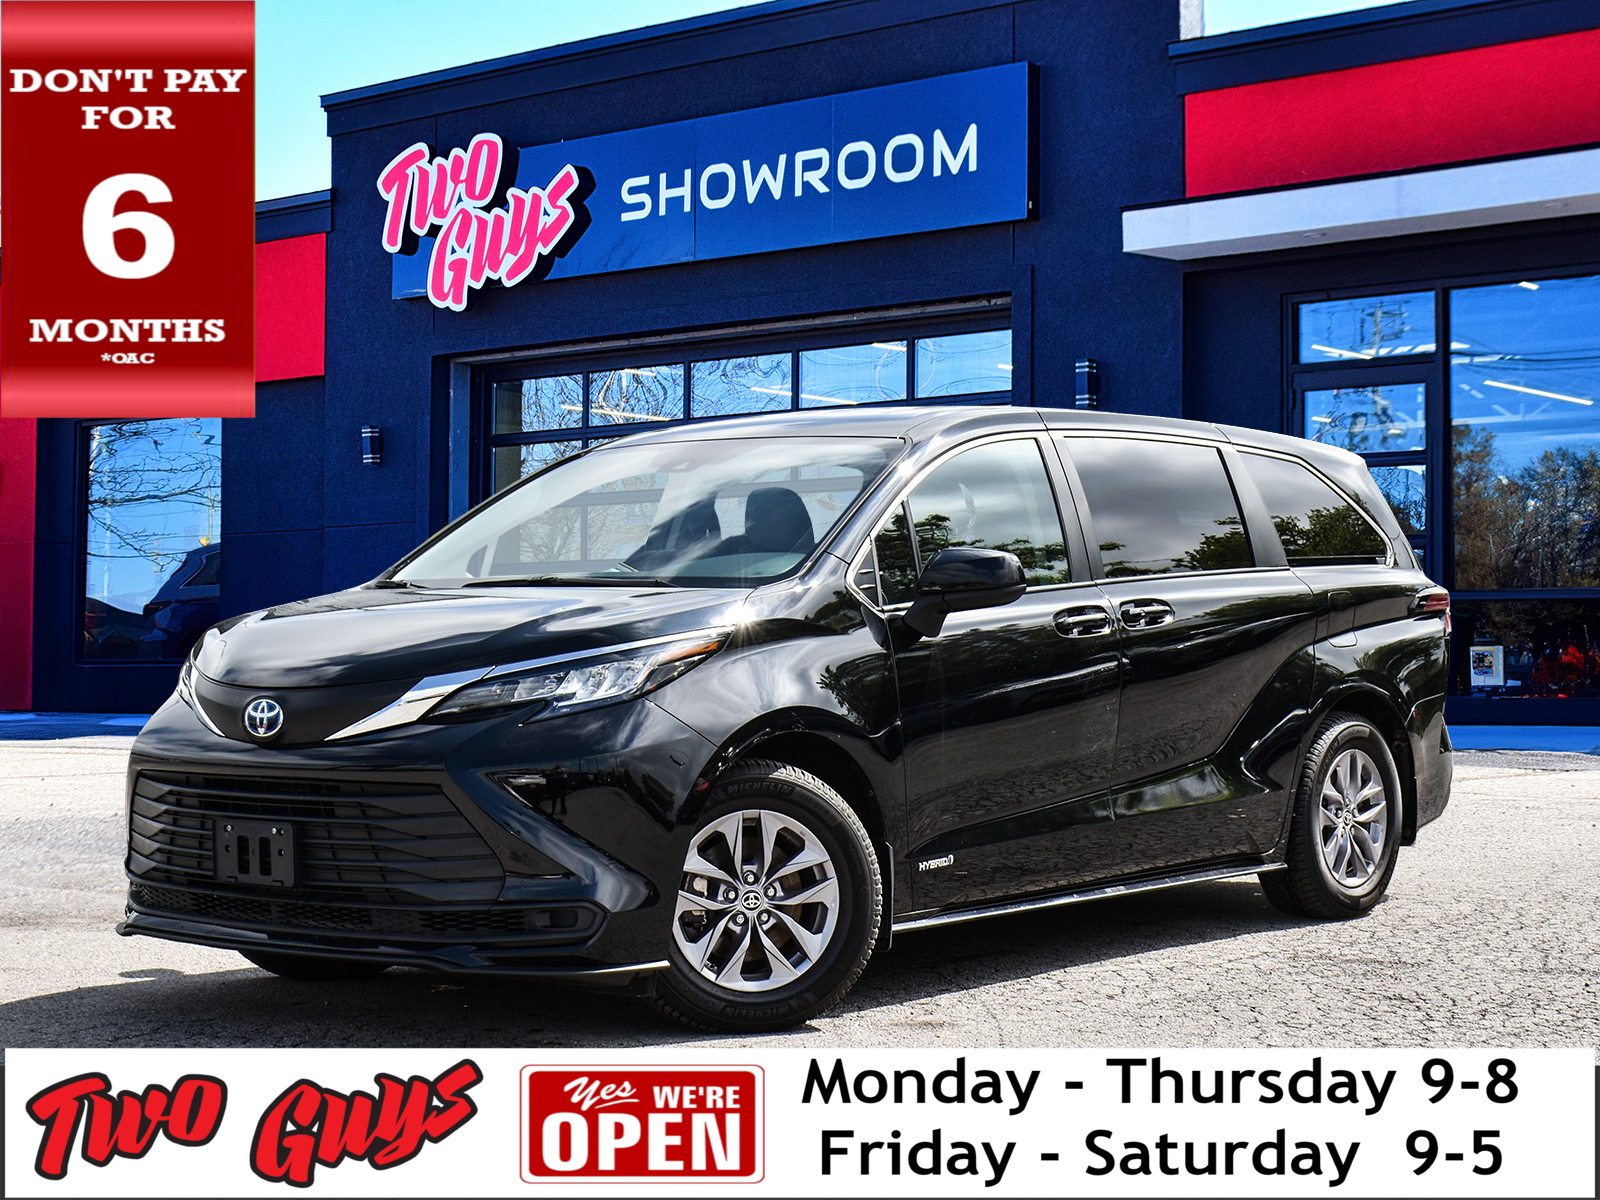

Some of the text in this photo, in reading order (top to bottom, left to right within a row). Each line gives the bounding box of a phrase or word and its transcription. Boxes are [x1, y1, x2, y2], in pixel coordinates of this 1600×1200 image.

[378, 136, 502, 250] Two
[620, 123, 978, 222] SHOWROOM
[428, 167, 577, 309] Guys
[727, 781, 793, 796] MICHELIN
[918, 856, 951, 872] HYBRID
